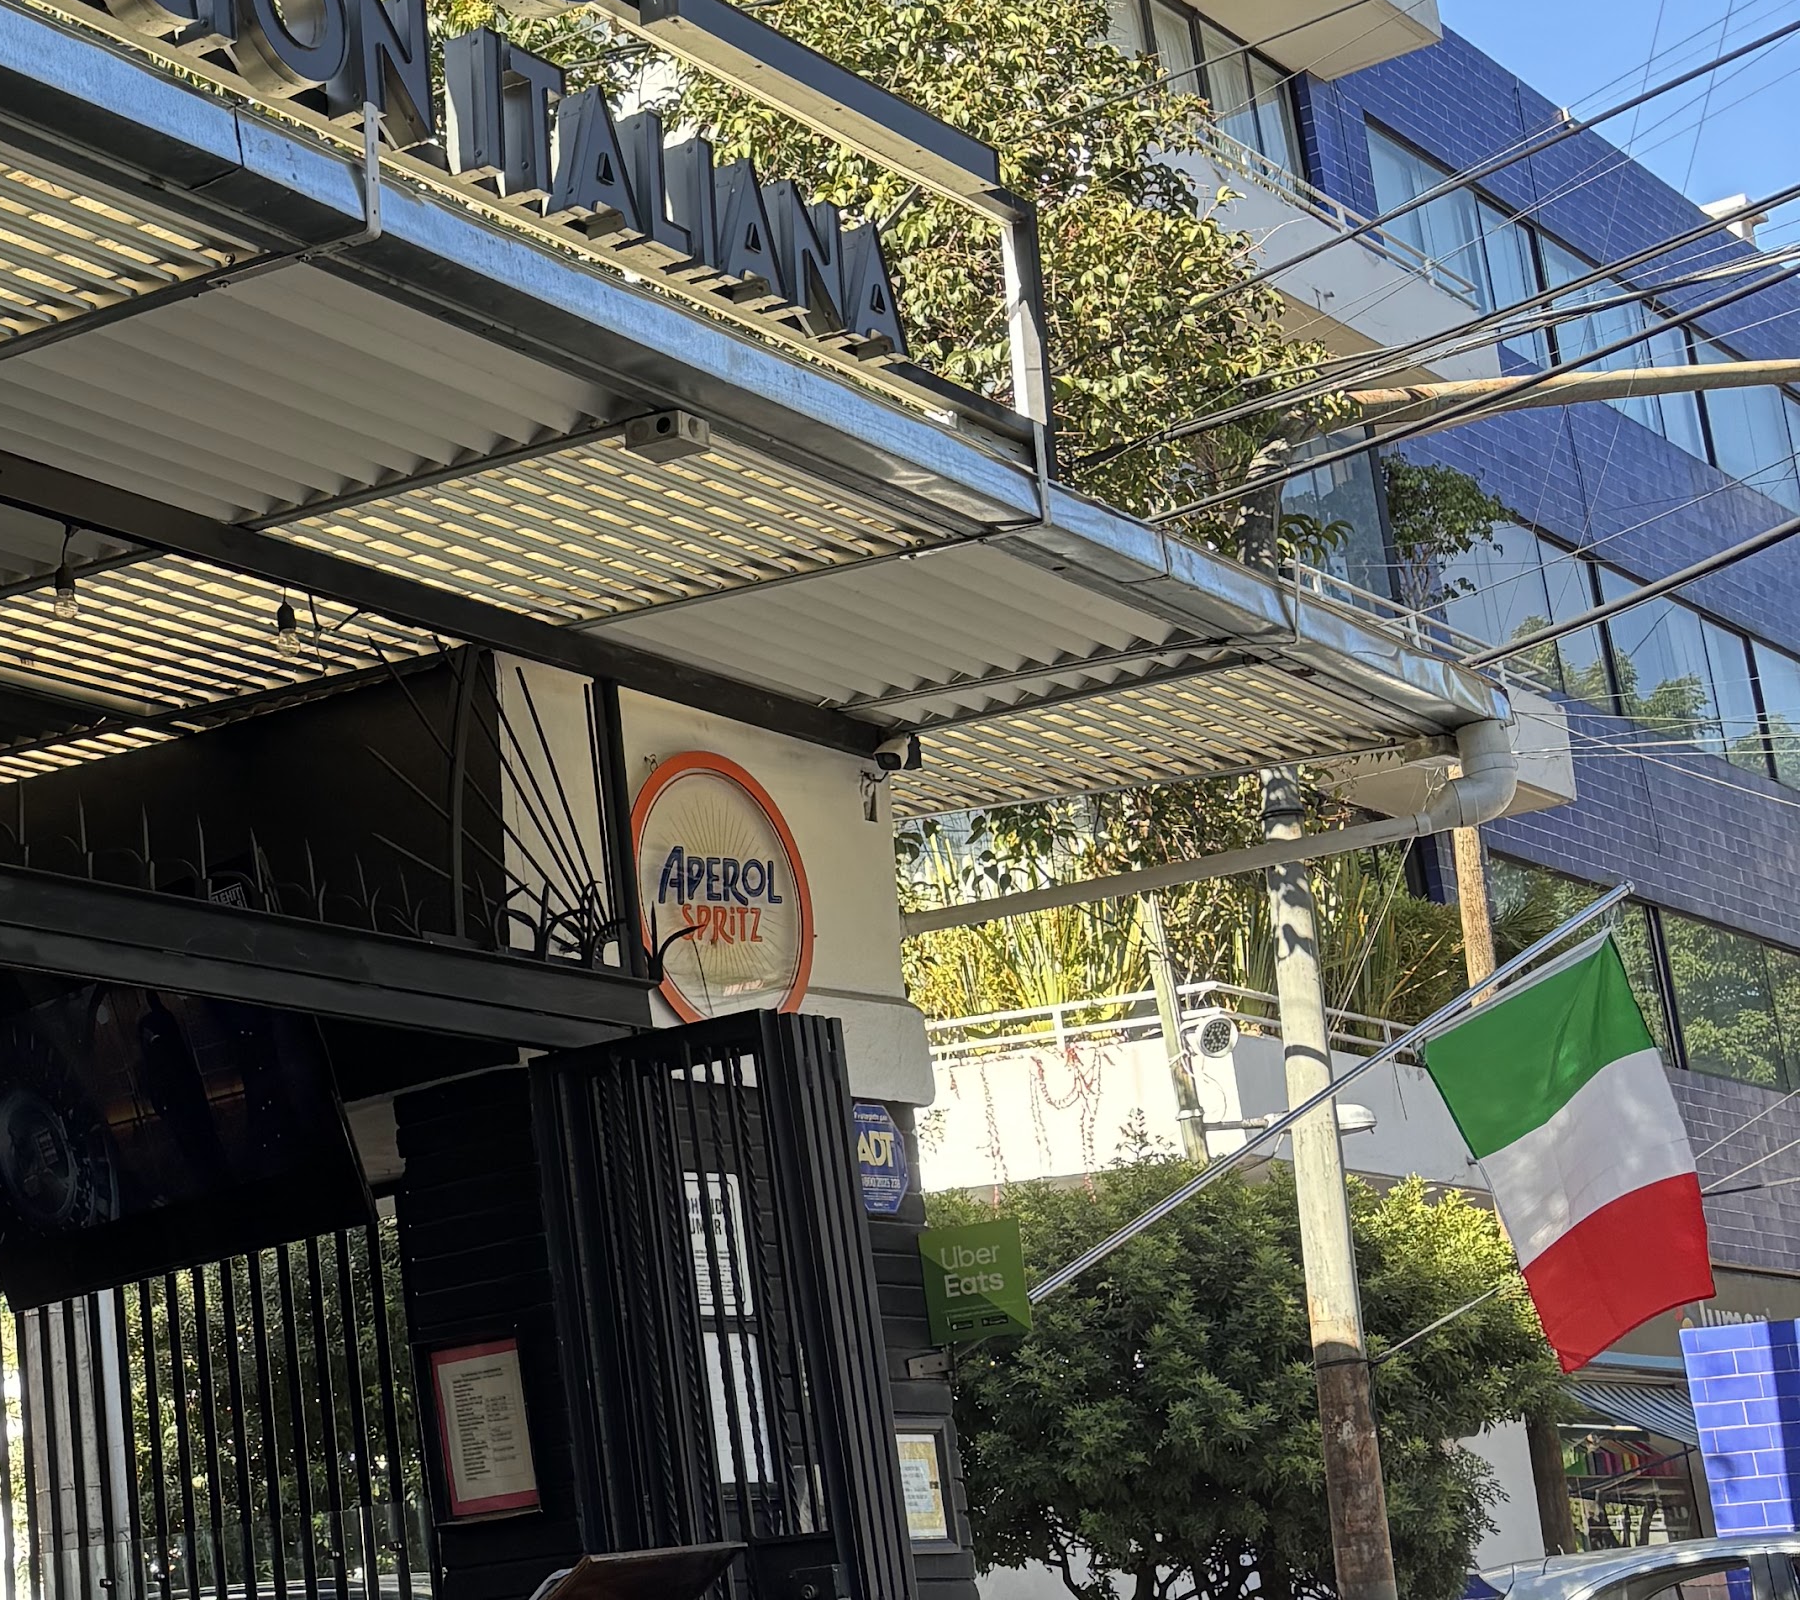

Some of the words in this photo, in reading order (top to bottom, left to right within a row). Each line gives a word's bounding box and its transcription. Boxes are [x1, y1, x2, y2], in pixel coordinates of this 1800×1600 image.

[445, 27, 908, 360] ITALIANA
[658, 845, 783, 905] APEROL
[857, 1131, 894, 1168] ADT
[940, 1245, 1000, 1270] Uber
[944, 1271, 1005, 1298] Eats
[1699, 1299, 1768, 1327] lum
